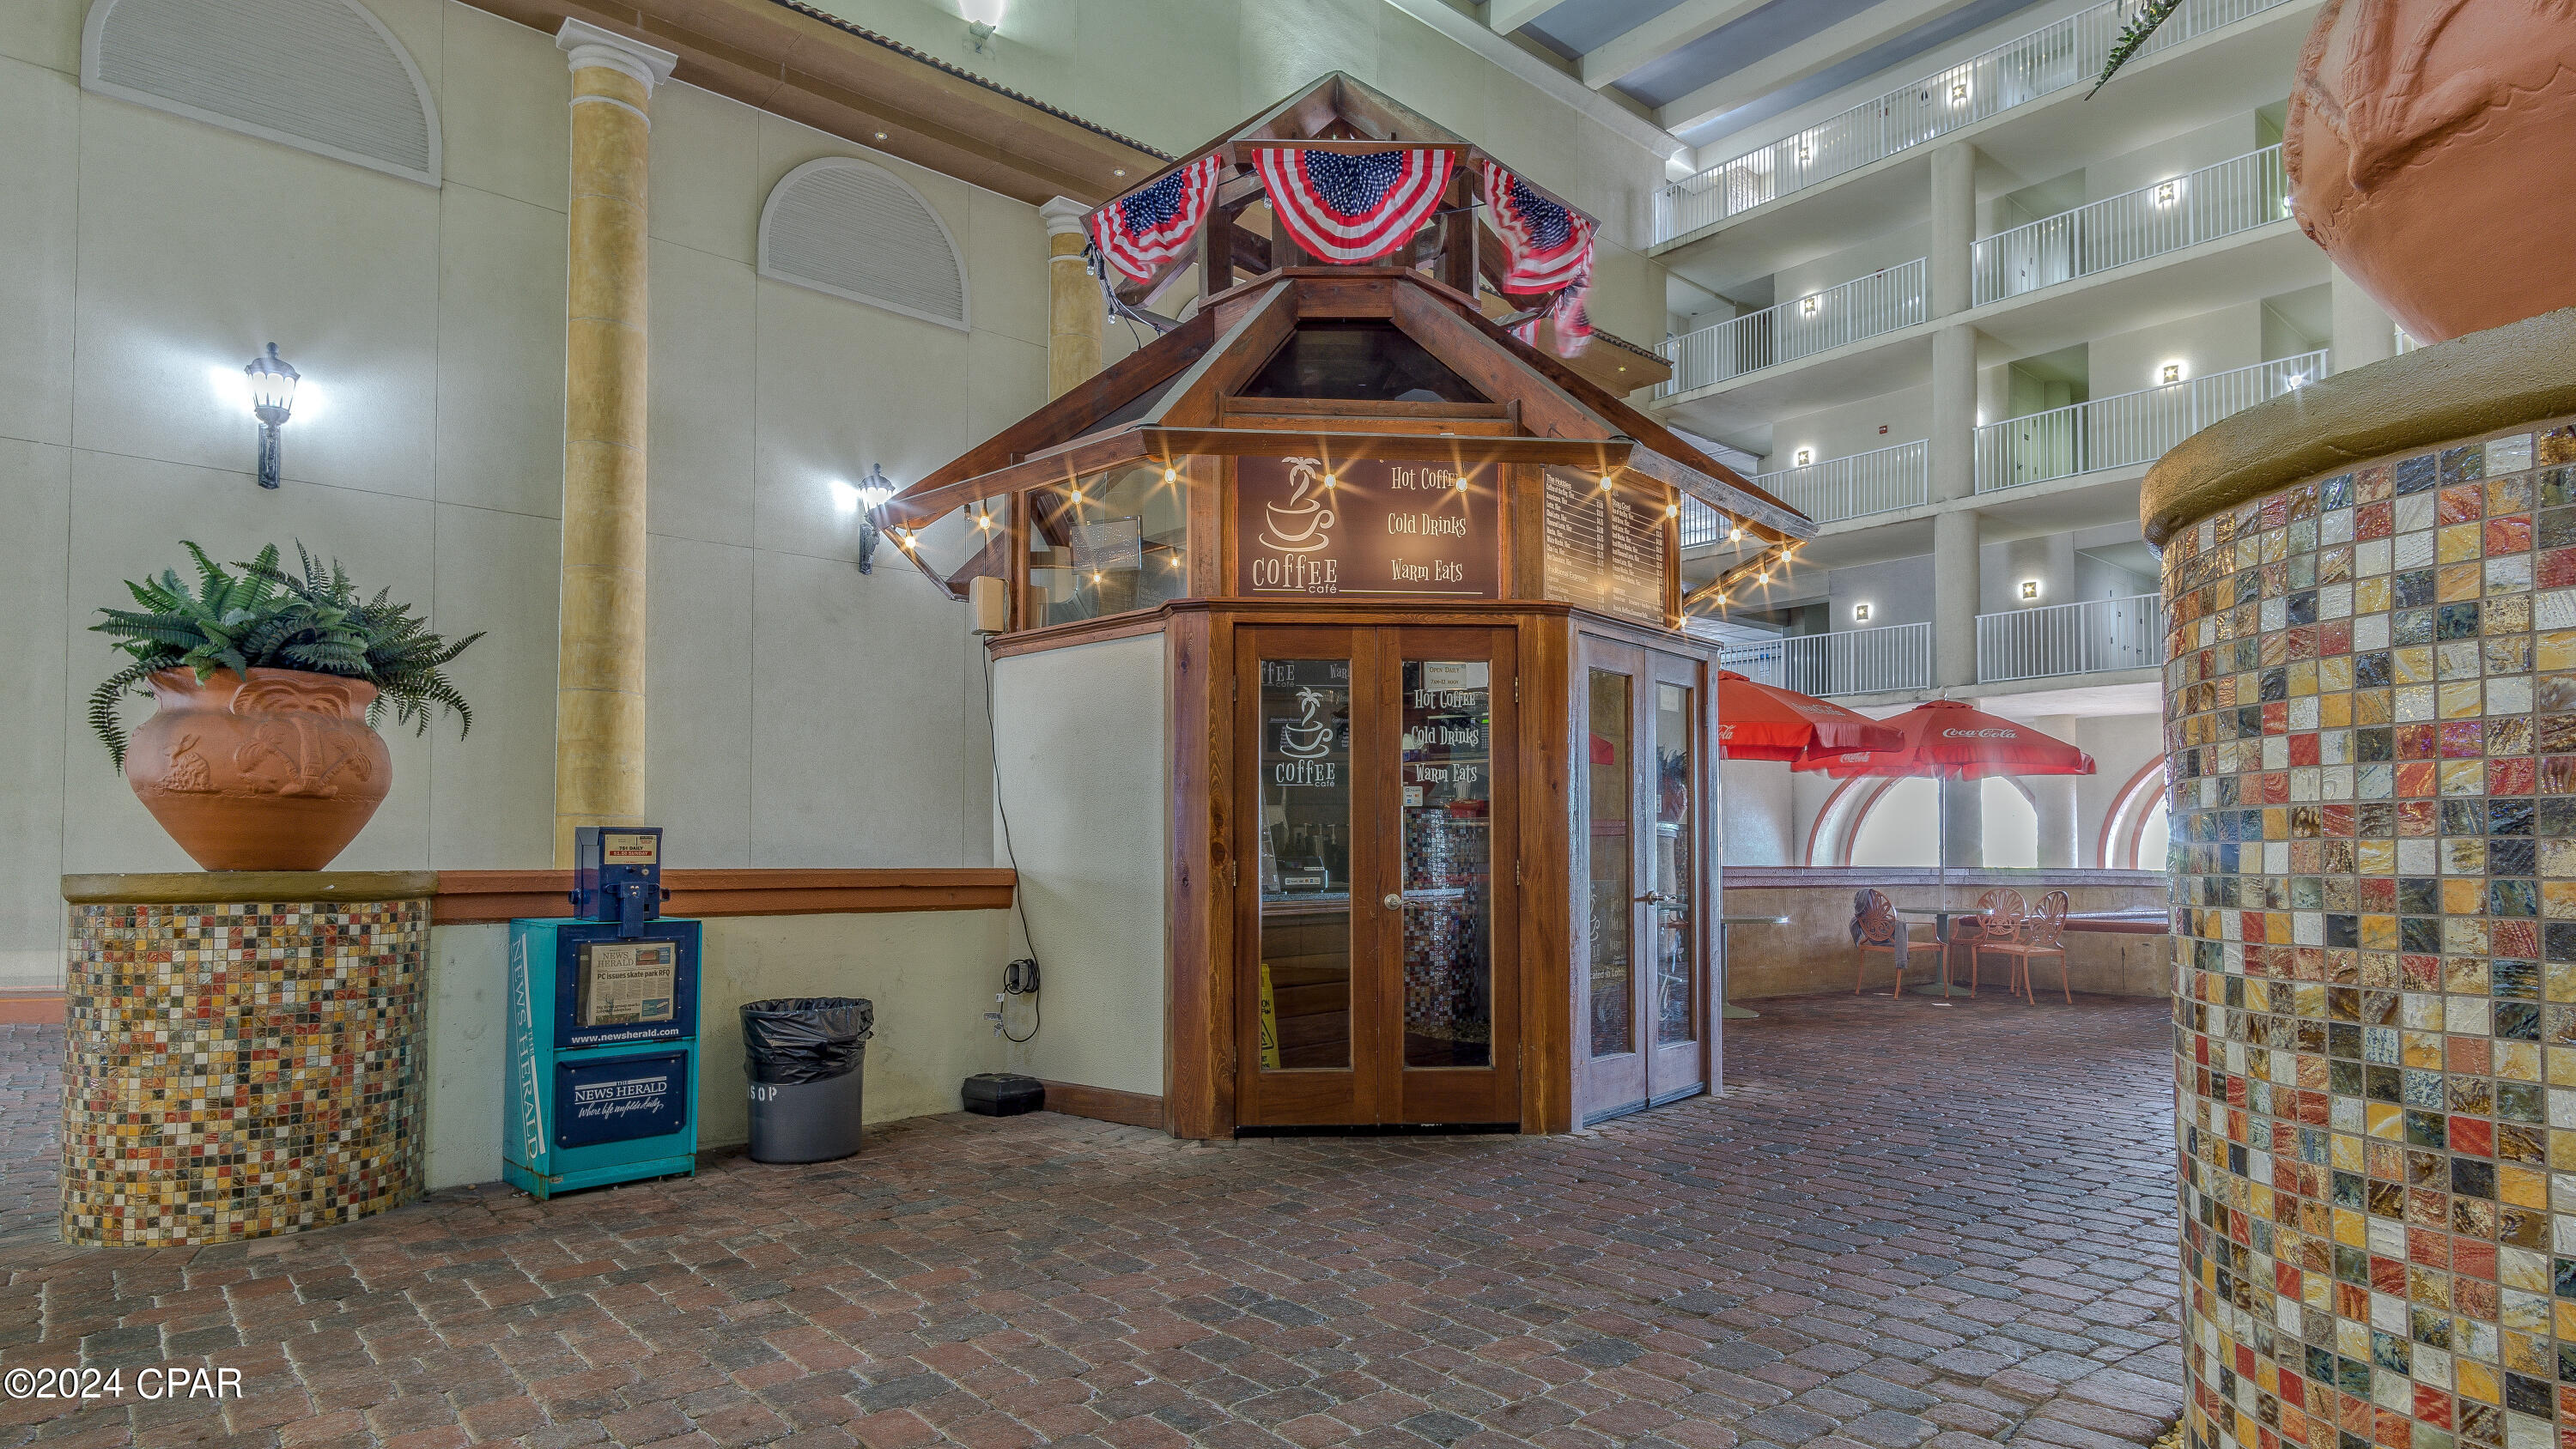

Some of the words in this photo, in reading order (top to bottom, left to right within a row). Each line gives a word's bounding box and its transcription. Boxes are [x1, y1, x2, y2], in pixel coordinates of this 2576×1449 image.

[1391, 467, 1416, 491] Hot
[1388, 512, 1417, 534] Cold
[1422, 513, 1466, 538] Drinks
[1391, 558, 1430, 582] Warm
[1435, 560, 1463, 582] Eats
[1308, 584, 1337, 594] café
[1330, 664, 1350, 680] War
[1414, 689, 1436, 709] Hot
[1440, 690, 1476, 708] Coffee
[1411, 726, 1437, 744] Cold
[1440, 726, 1479, 747] Drinks
[1943, 728, 2019, 738] Coca-Cola
[1415, 763, 1449, 783] Warm
[1452, 763, 1477, 783] Eats
[597, 959, 634, 967] HERALD
[645, 970, 658, 978] park
[571, 1028, 679, 1043] www.newsherald.com
[512, 937, 526, 1026] NEWS
[519, 1031, 539, 1160] HERALD
[575, 1088, 613, 1102] NEWS
[616, 1082, 667, 1096] HERALD
[579, 1102, 601, 1118] Where
[602, 1102, 613, 1119] life
[615, 1100, 640, 1118] unfolds
